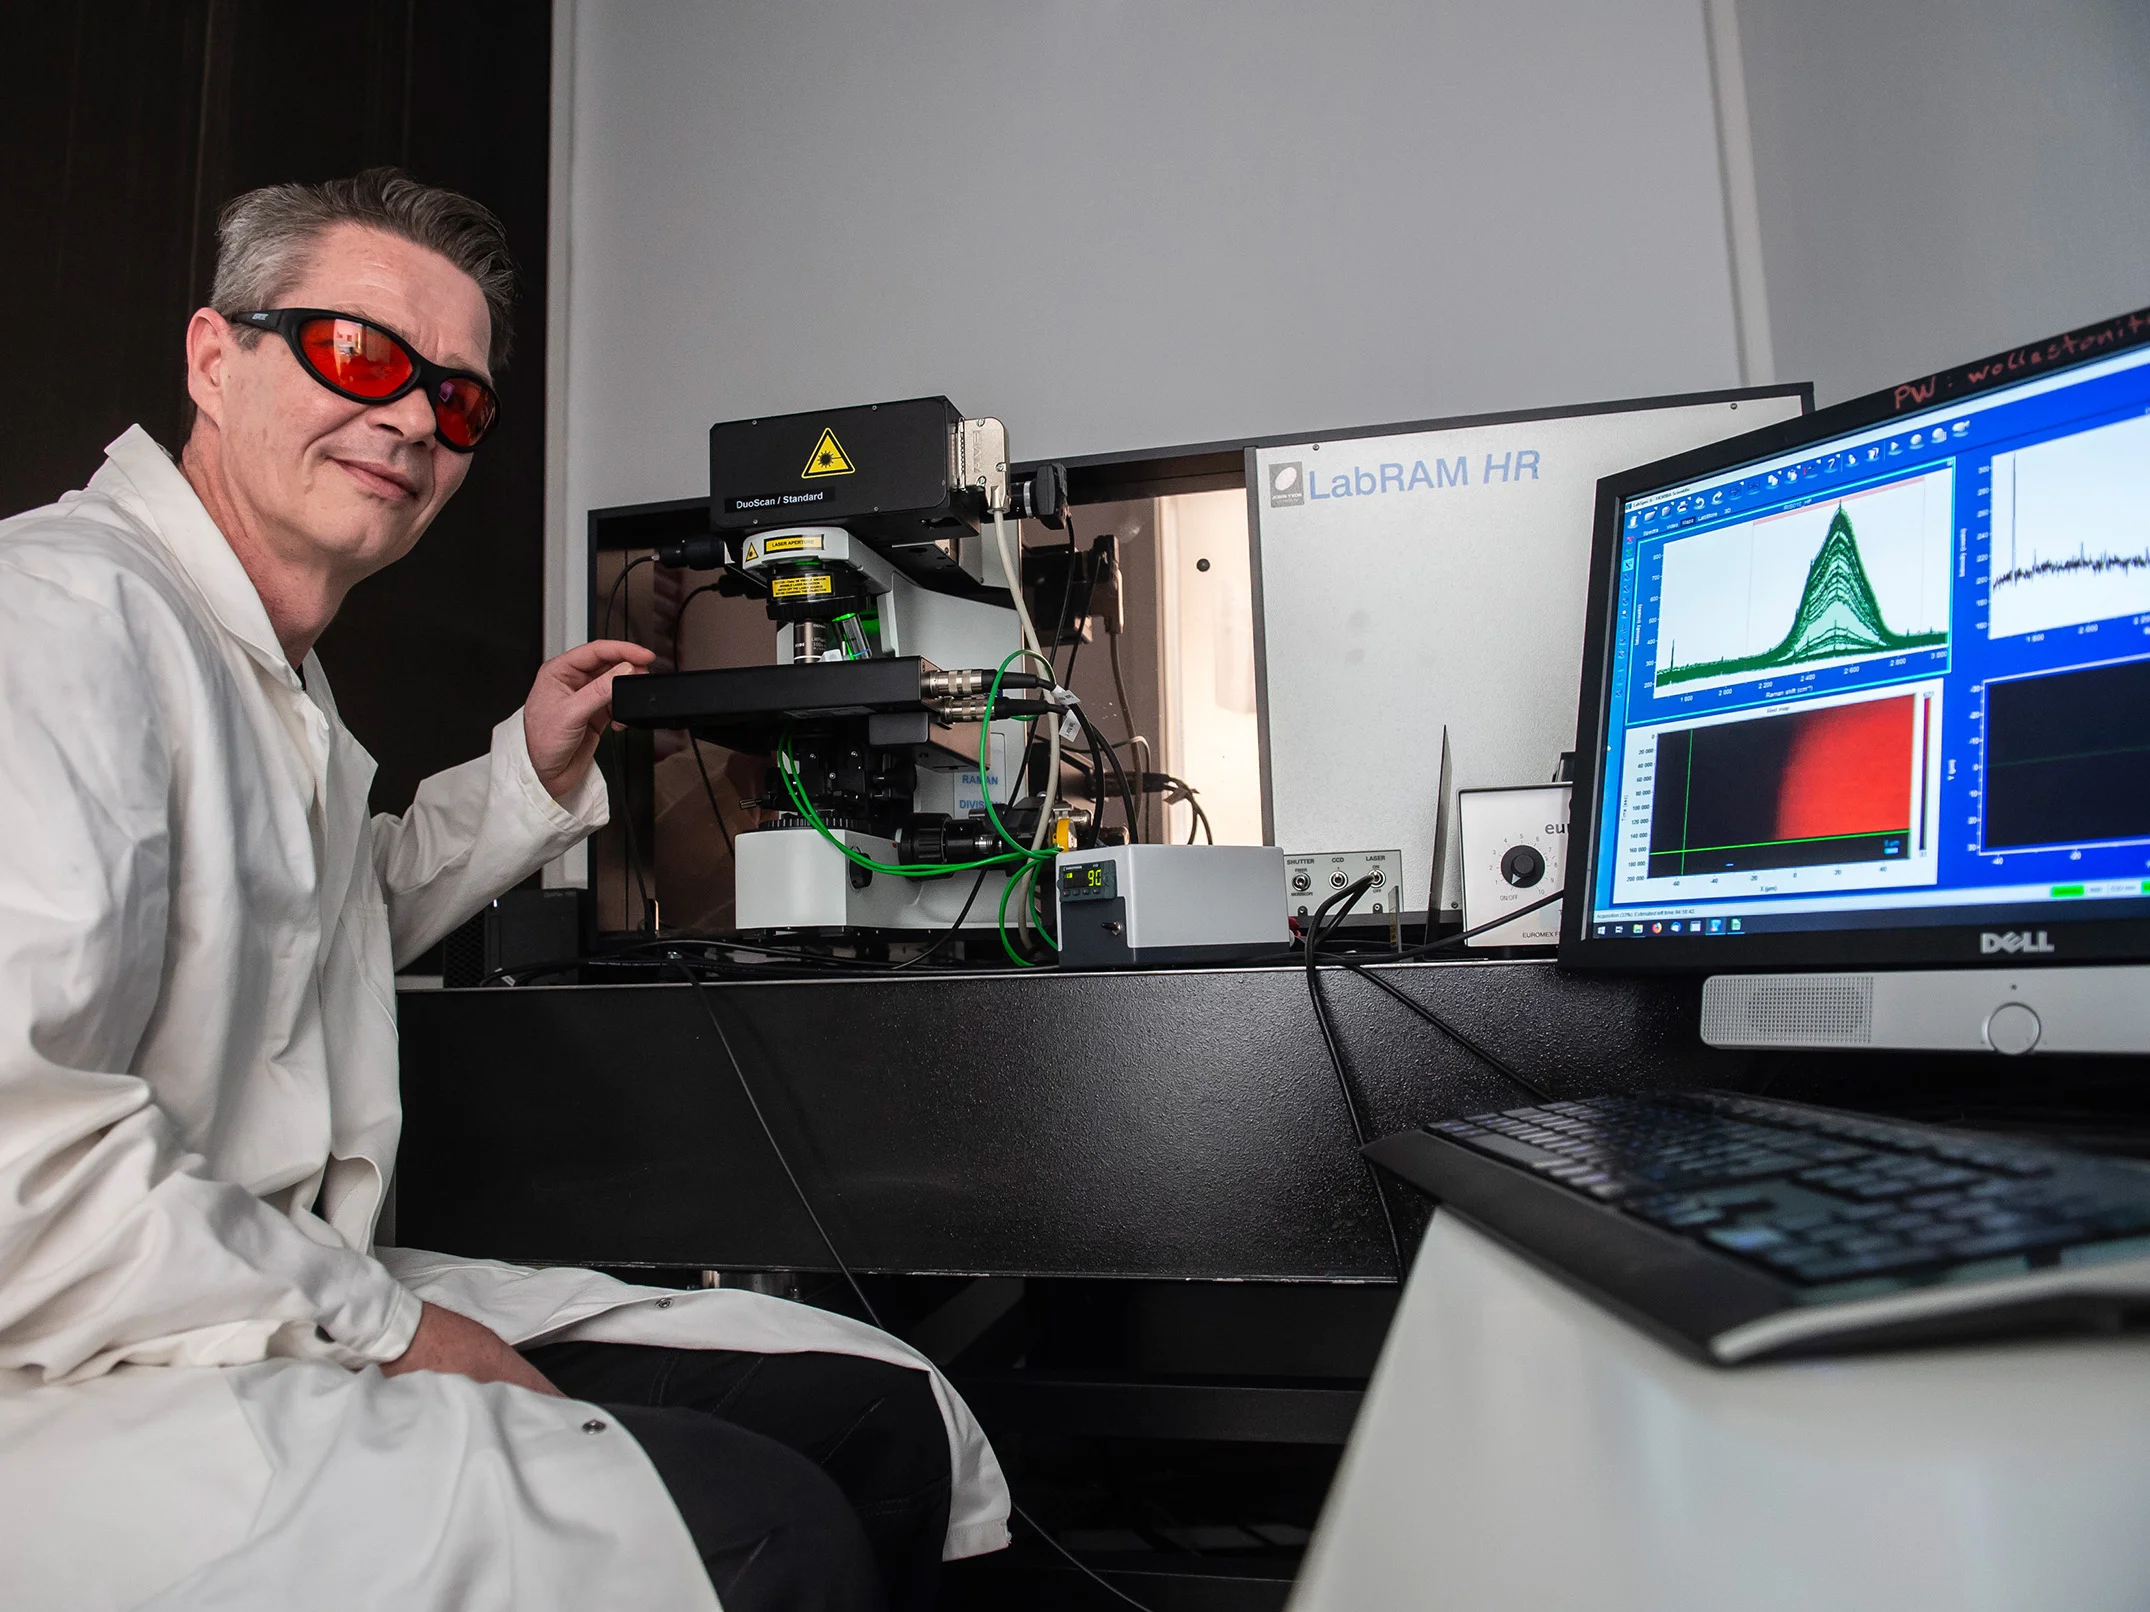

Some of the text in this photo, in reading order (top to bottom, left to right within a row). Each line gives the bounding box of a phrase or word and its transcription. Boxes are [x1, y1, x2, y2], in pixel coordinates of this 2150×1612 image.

[1309, 450, 1541, 500] LabRAM HR
[736, 492, 823, 509] DuoScan / Standard
[1287, 858, 1315, 866] SHUTTER
[1522, 931, 1554, 939] EUROMEX
[1980, 931, 2055, 954] DELL
